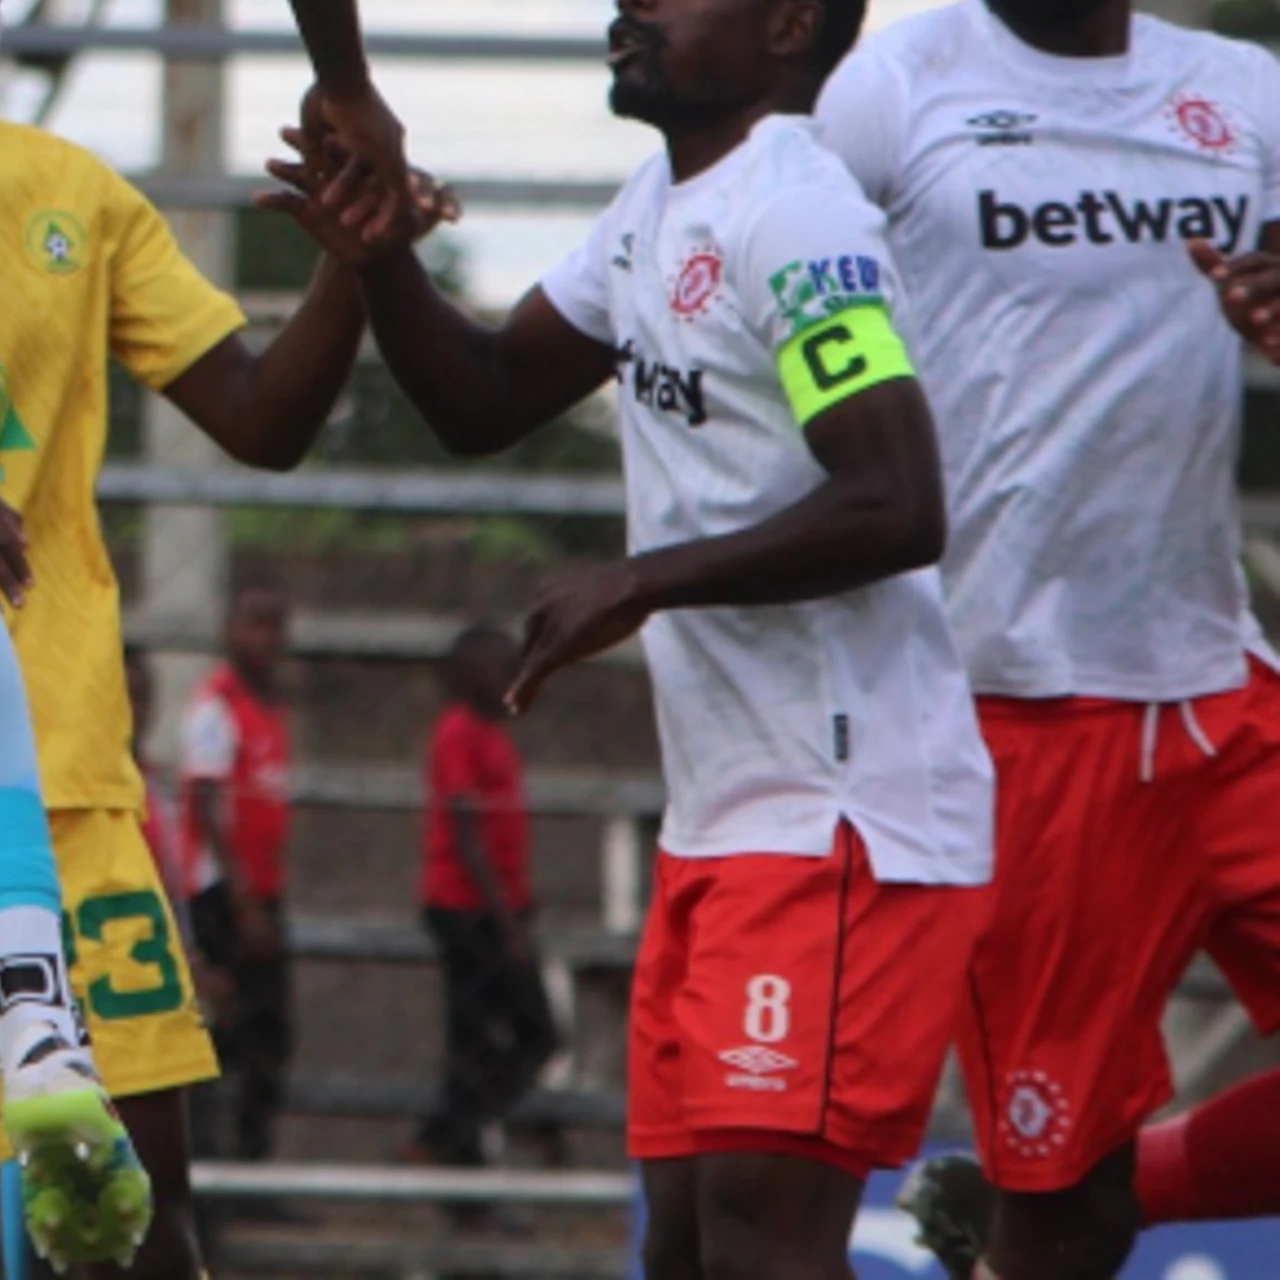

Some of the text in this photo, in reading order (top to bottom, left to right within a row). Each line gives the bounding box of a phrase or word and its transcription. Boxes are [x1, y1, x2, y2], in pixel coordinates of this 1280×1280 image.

[977, 188, 1250, 254] betway
[802, 322, 867, 392] C
[60, 890, 184, 1020] 3
[744, 973, 791, 1042] 8
